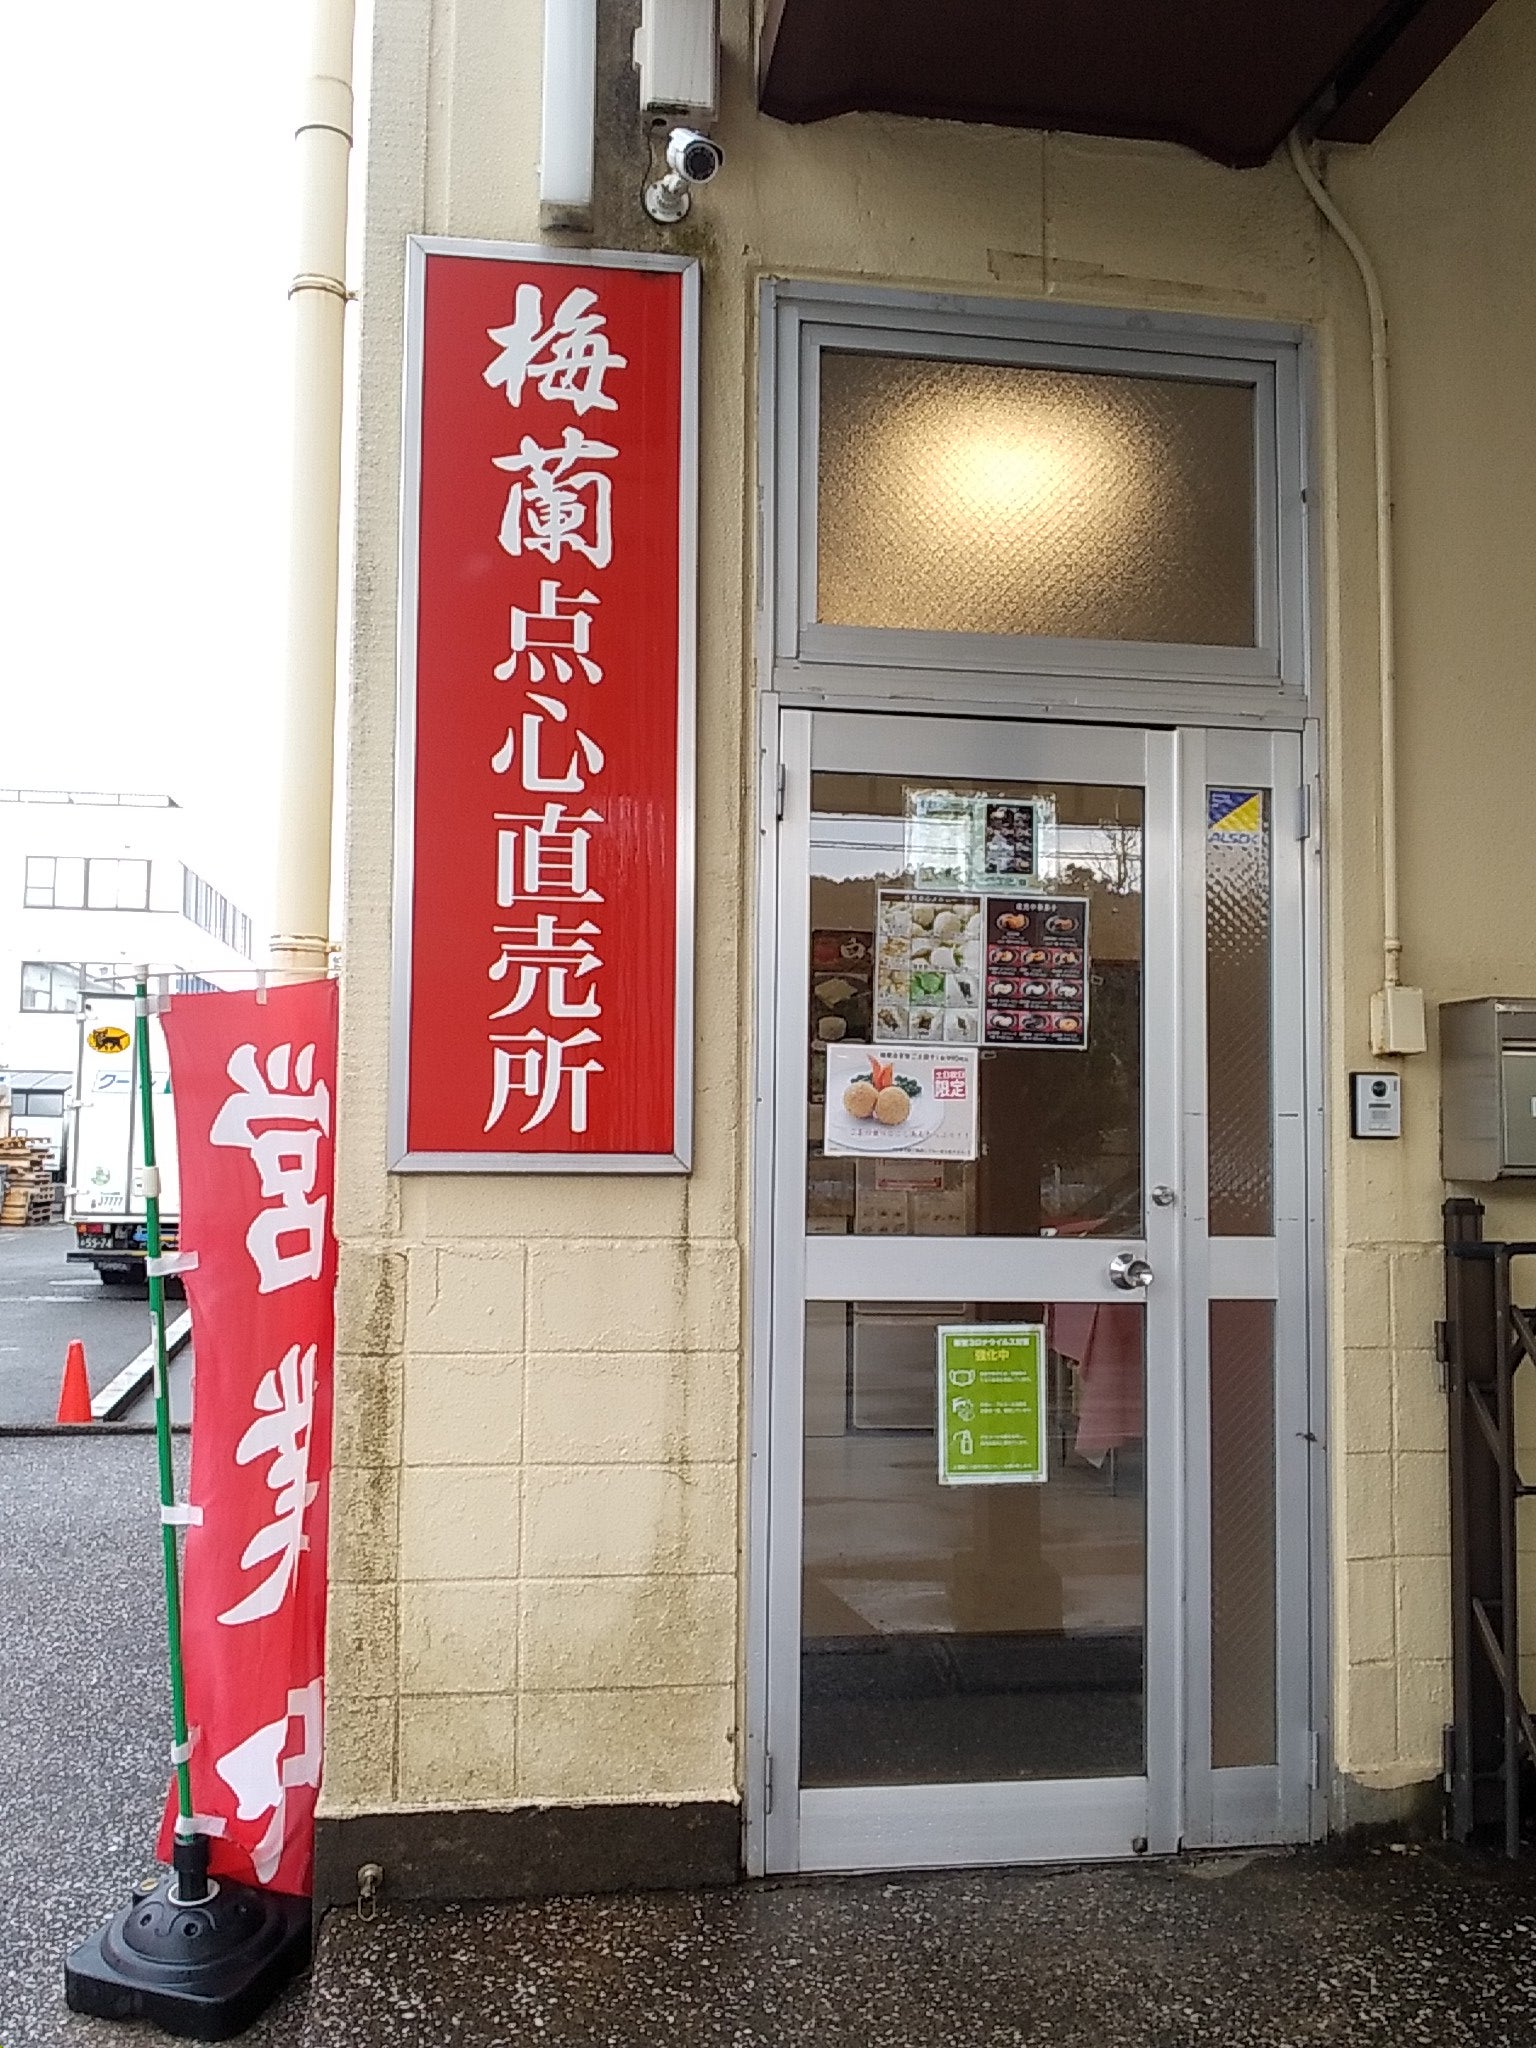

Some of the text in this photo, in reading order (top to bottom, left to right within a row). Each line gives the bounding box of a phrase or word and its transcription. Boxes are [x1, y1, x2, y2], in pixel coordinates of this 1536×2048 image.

[482, 284, 628, 1134] 梅蘭点心直売所
[1207, 832, 1259, 844] ALSOK
[935, 1079, 966, 1098] 限定
